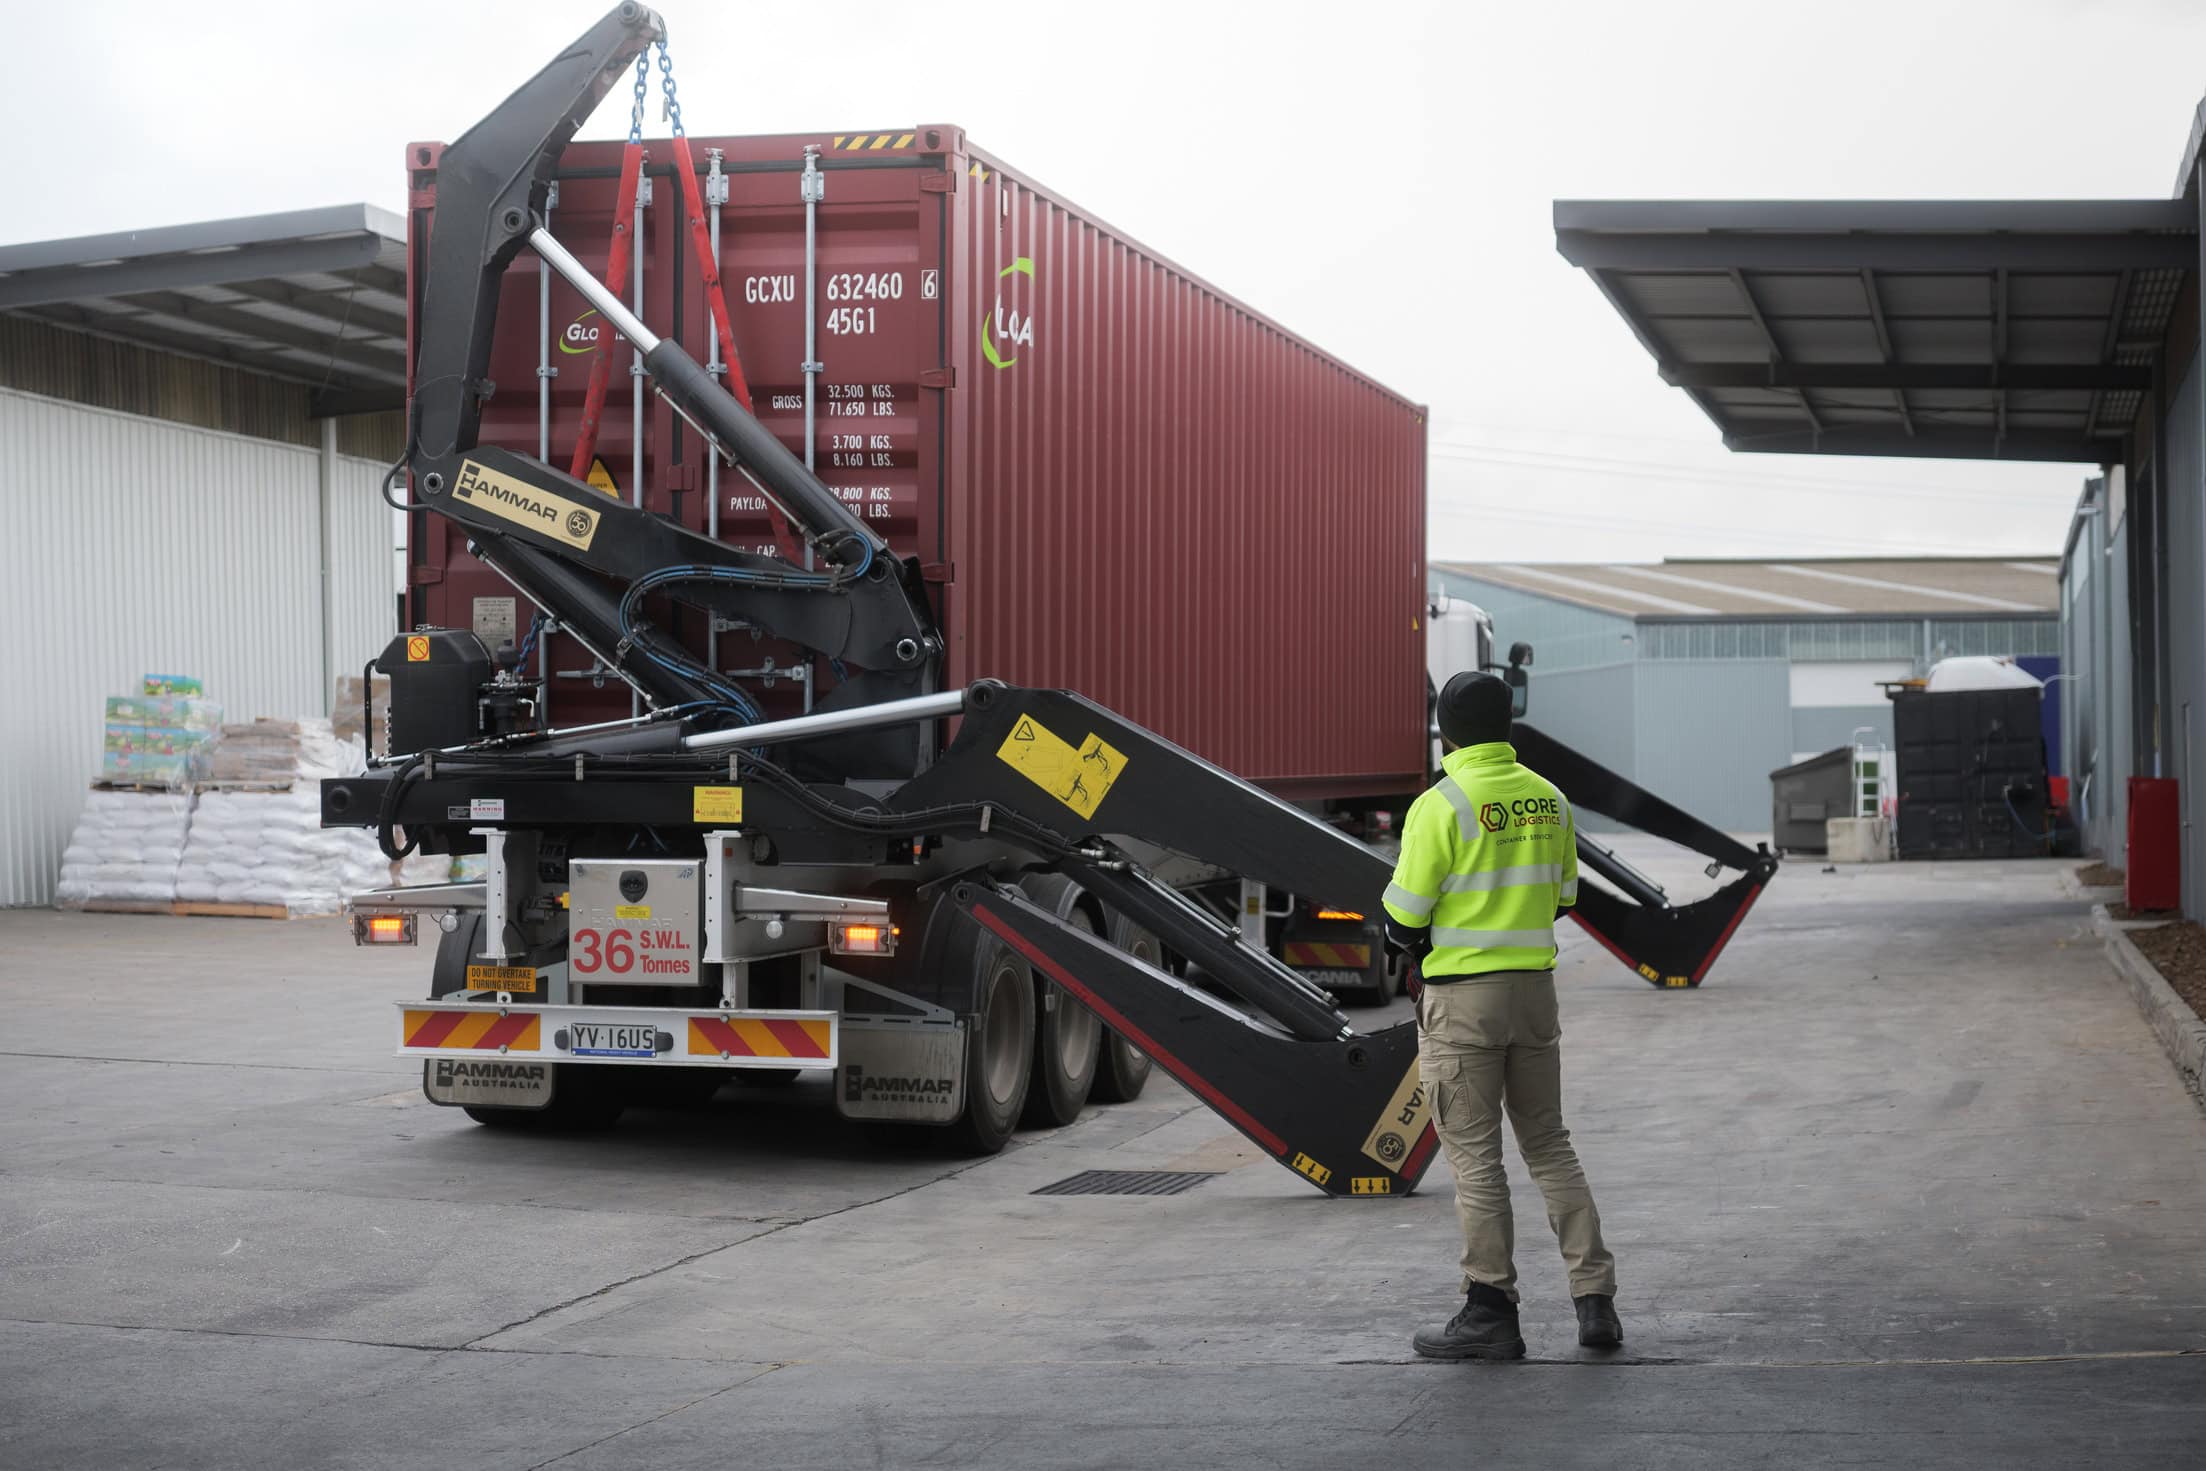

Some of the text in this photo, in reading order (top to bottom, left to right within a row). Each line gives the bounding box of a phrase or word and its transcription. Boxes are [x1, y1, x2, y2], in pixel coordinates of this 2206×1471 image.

[746, 272, 936, 303] GCXU 632460 6
[826, 307, 876, 335] 45G1
[828, 384, 895, 398] 32.500 KGS.
[772, 395, 802, 409] GROSS
[829, 402, 896, 416] 71.650 LBS.
[832, 435, 893, 449] 3.700 KGS.
[833, 453, 894, 466] 8.160 LBS.
[460, 472, 559, 523] HAMMAR
[829, 487, 892, 500] 8.800 KGS.
[730, 497, 768, 510] PAYLOA
[869, 504, 892, 517] LBS.
[757, 545, 778, 558] CAP.
[1511, 798, 1559, 816] CORE
[1514, 816, 1561, 828] LOGISTICS
[640, 930, 690, 949] S.W.L.
[574, 928, 635, 974] 36
[640, 955, 690, 974] Tonnes
[472, 968, 531, 979] DO NOT OVERTAKE
[473, 979, 531, 991] TURNING VEHICLE
[437, 1061, 545, 1081] HAMMAR
[462, 1079, 540, 1090] AUSTRALIA
[846, 1074, 953, 1095] HAMMAR
[871, 1093, 949, 1104] AUSTRALIA
